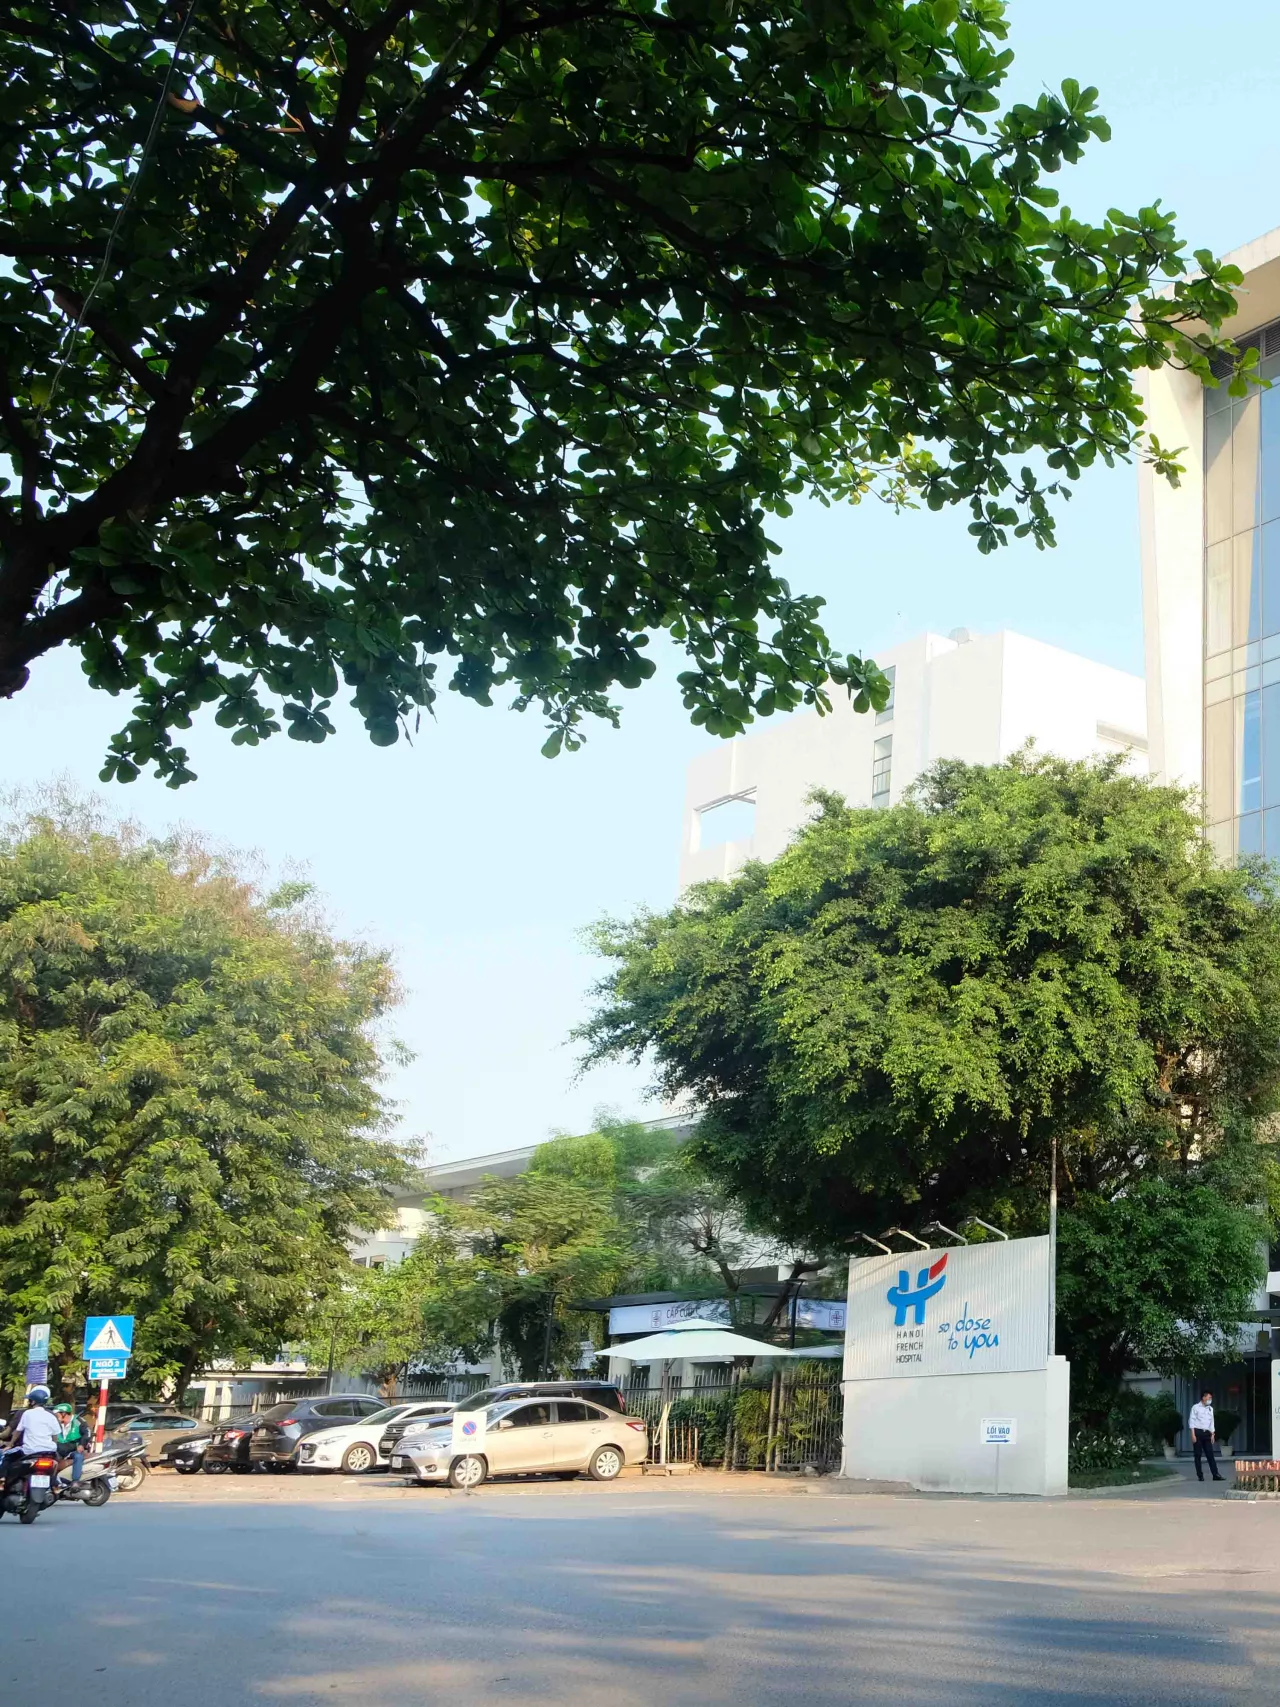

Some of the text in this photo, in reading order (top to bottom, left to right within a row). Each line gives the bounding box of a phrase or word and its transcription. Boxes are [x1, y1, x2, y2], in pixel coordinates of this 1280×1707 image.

[938, 1323, 950, 1333] so
[896, 1329, 924, 1339] HANOI
[896, 1341, 924, 1351] FRENCH
[948, 1332, 999, 1359] to you
[895, 1354, 922, 1363] HOSPITAL
